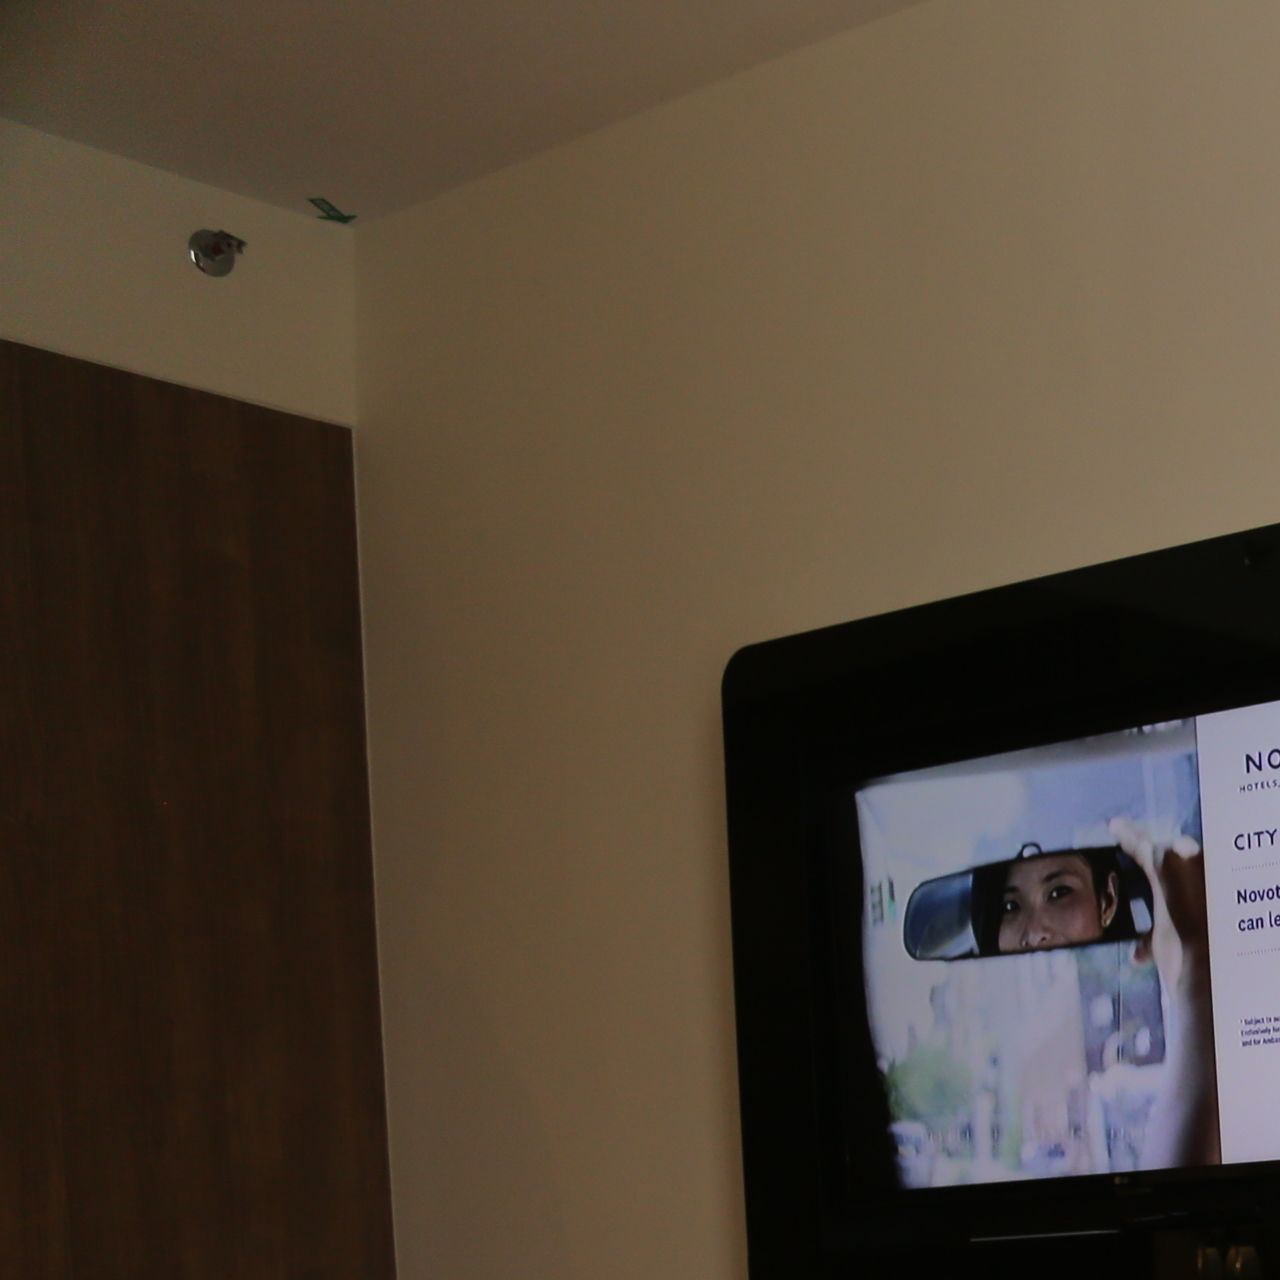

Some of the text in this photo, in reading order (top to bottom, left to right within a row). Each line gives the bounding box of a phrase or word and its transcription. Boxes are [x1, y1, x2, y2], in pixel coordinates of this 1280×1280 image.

[1239, 779, 1280, 793] HOTELS,
[1234, 828, 1277, 850] CITY
[1238, 916, 1264, 932] can
